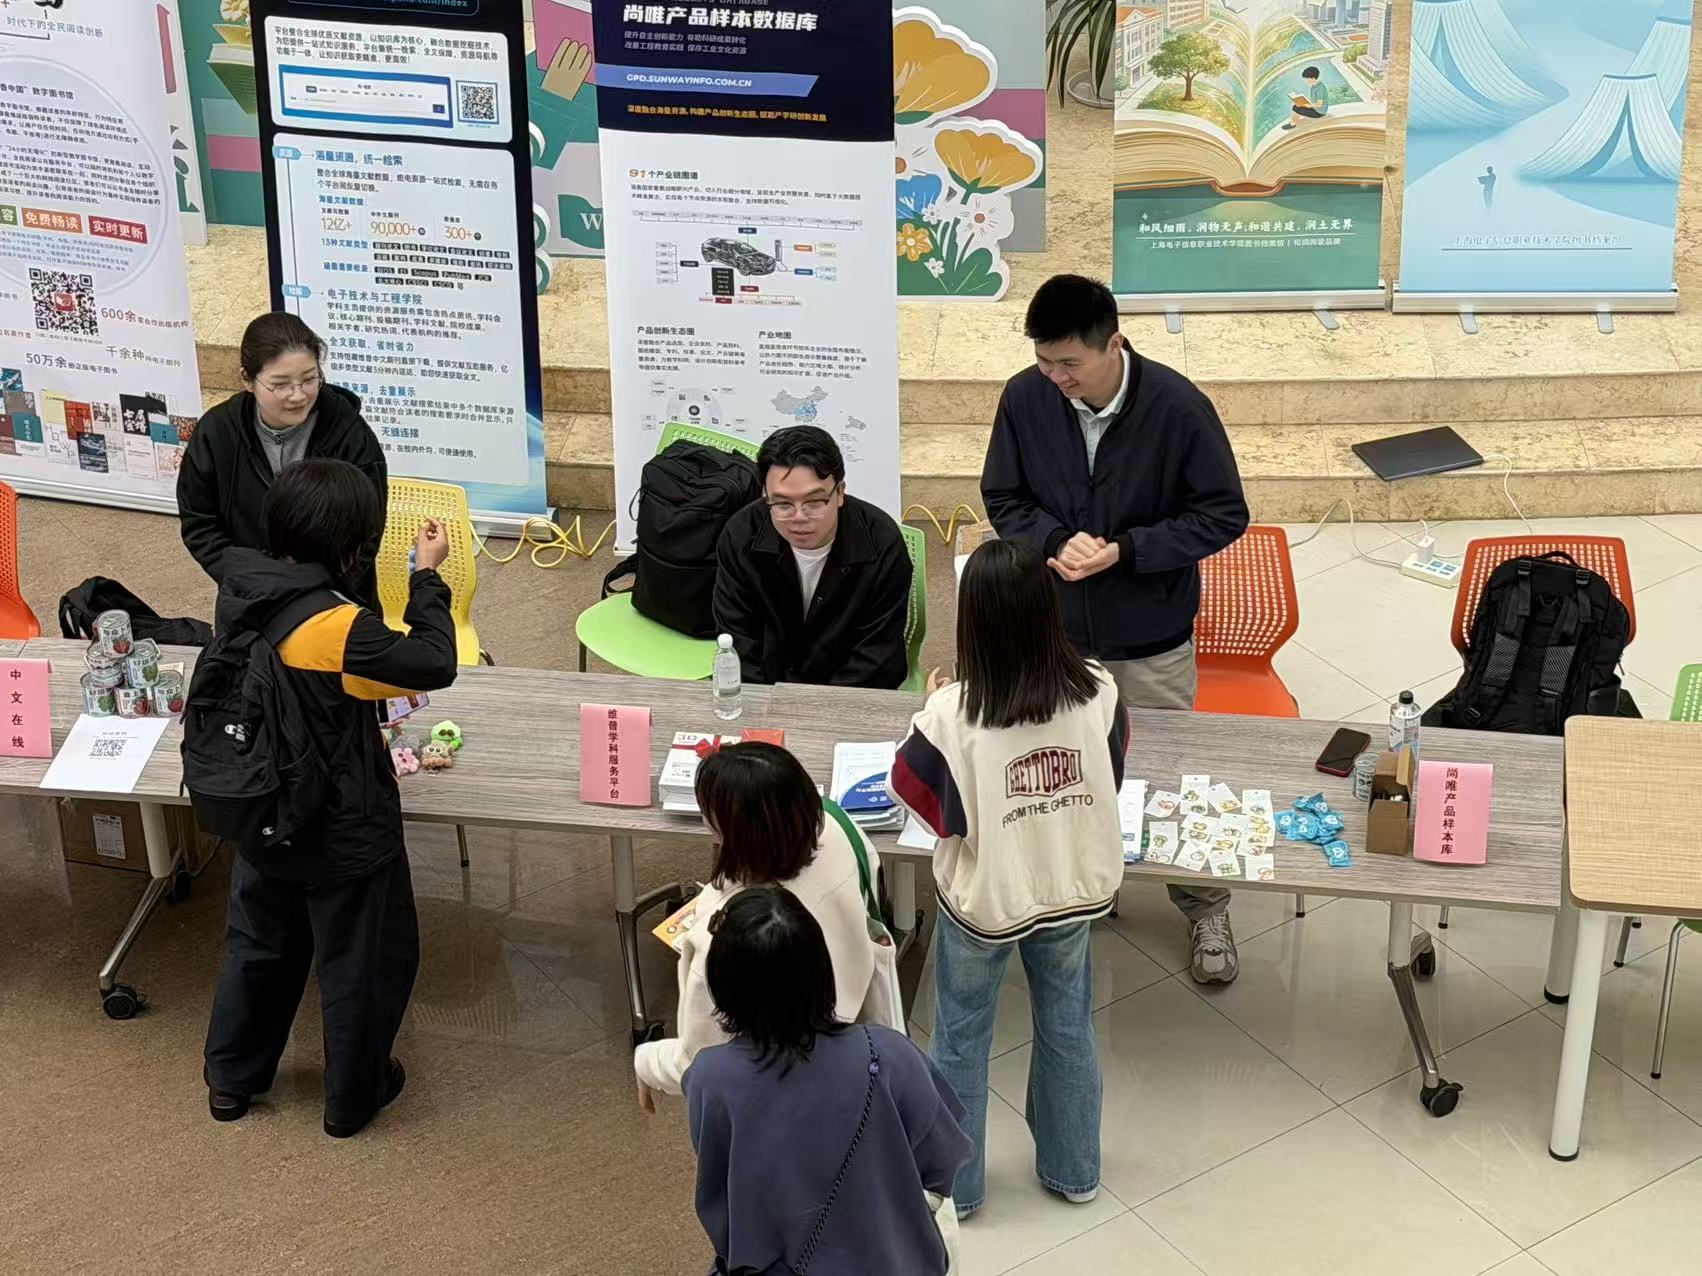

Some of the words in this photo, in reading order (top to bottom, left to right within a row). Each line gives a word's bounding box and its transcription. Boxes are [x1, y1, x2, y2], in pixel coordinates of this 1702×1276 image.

[623, 4, 818, 31] 尚唯产品样本数据库
[1, 208, 14, 221] 容
[25, 211, 79, 230] 免费畅读
[92, 219, 144, 240] 实时更新
[327, 288, 423, 305] 电子技术与工程学院
[330, 336, 414, 352] 全文获取、省时省力
[759, 331, 791, 339] 产业地图
[10, 669, 24, 748] 中文在线
[607, 709, 620, 799] 维普学科服务平台
[1009, 750, 1078, 793] GHETTOBRO
[1002, 806, 1027, 828] FROM
[1026, 801, 1050, 816] THE
[1050, 794, 1094, 812] GHETTO
[1440, 768, 1459, 855] 尚唯产品样本库
